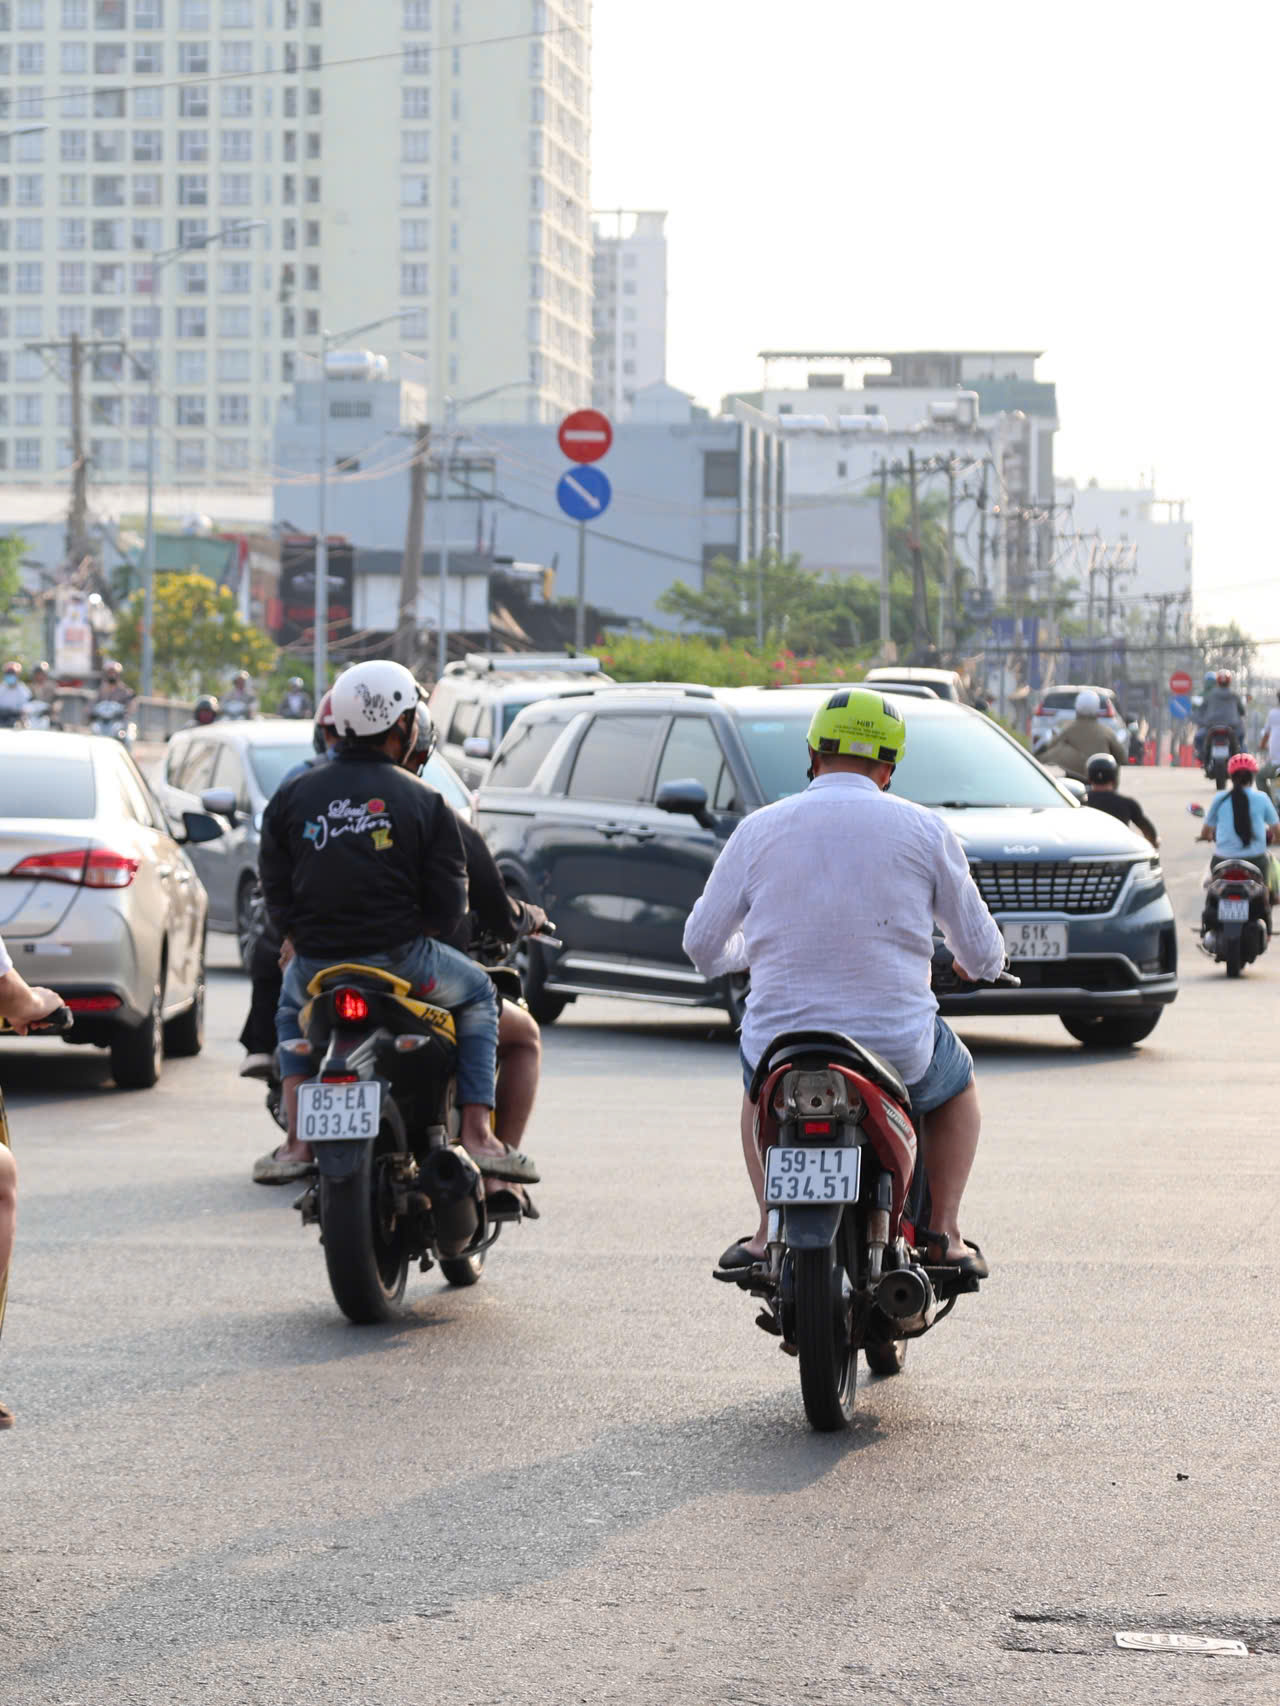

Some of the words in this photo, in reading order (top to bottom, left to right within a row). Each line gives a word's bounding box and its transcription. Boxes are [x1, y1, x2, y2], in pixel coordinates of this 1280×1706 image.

[1022, 925, 1048, 940] 61K
[422, 1007, 447, 1026] 155
[312, 1087, 366, 1112] 85-EA
[306, 1112, 371, 1137] 033.45
[780, 1150, 843, 1173] 59-L1
[770, 1176, 850, 1199] 534.51
